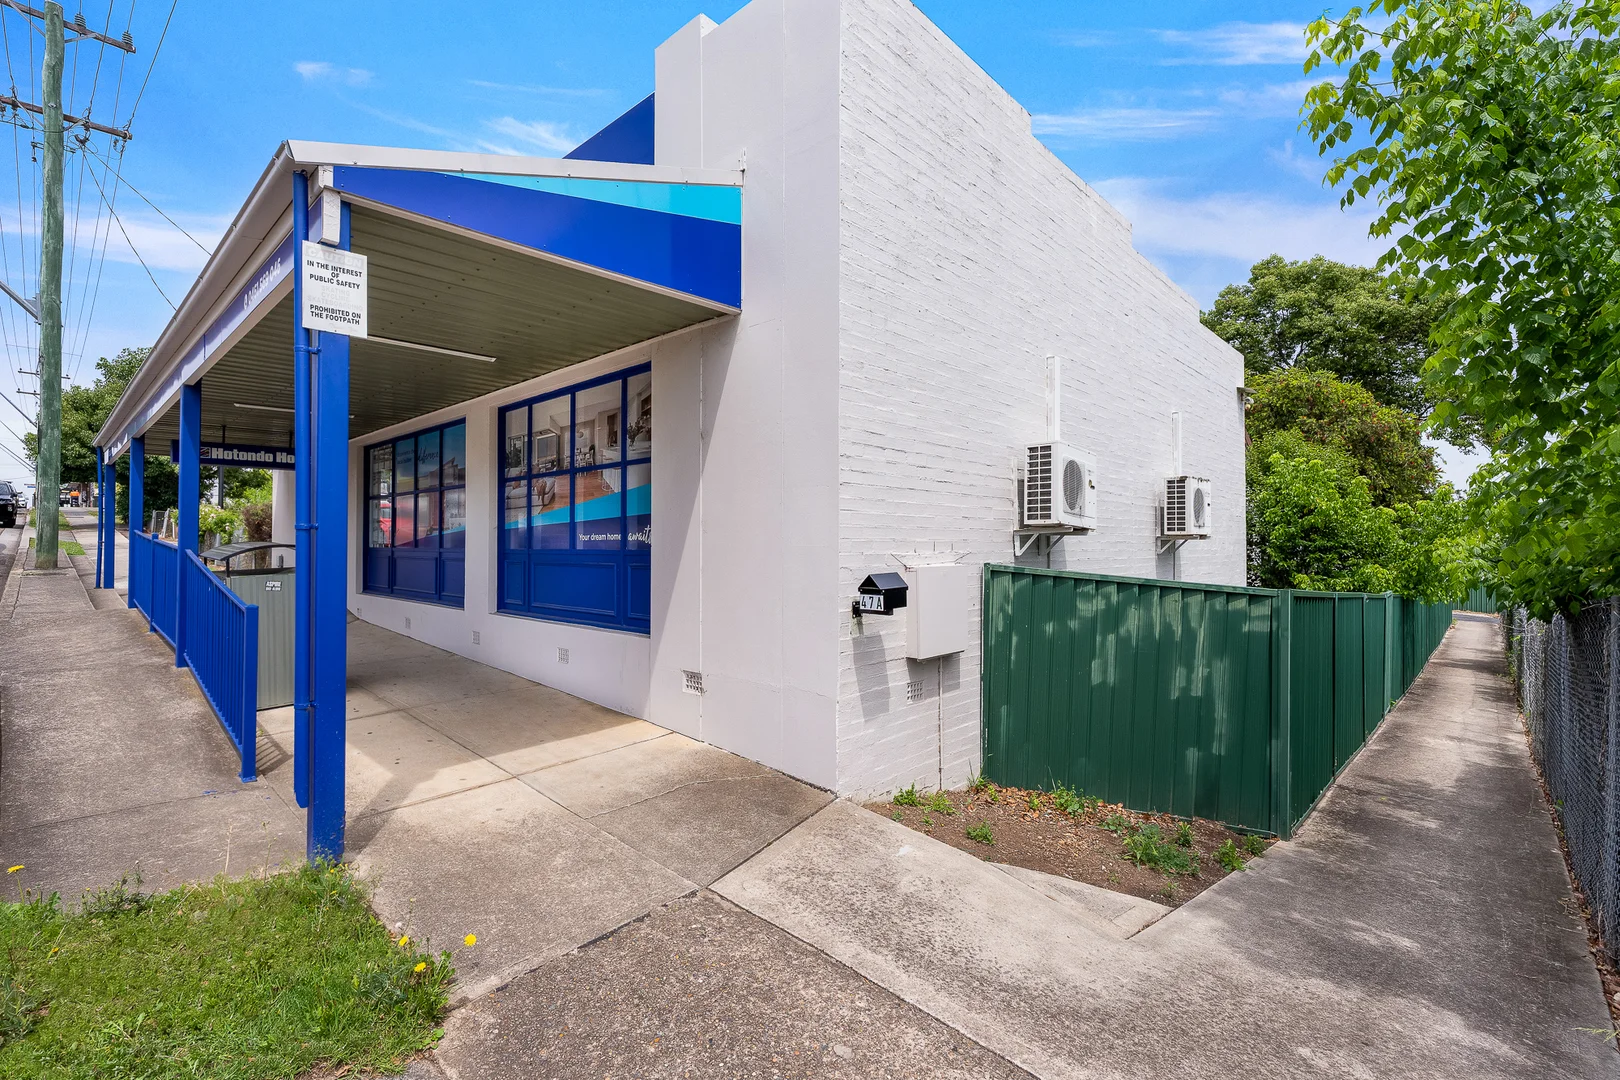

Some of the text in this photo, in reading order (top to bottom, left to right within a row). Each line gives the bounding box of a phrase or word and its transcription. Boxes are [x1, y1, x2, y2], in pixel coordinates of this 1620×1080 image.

[316, 262, 330, 270] THE
[330, 265, 362, 278] INTEREST
[310, 273, 360, 290] PUBLIC SAFETY
[310, 304, 361, 320] PROHIBITED ON
[310, 310, 360, 326] THE FOOTPATH
[212, 448, 274, 462] Hotondo
[578, 533, 590, 541] Your
[591, 532, 606, 541] dream
[607, 532, 622, 541] home
[861, 595, 882, 610] 47A
